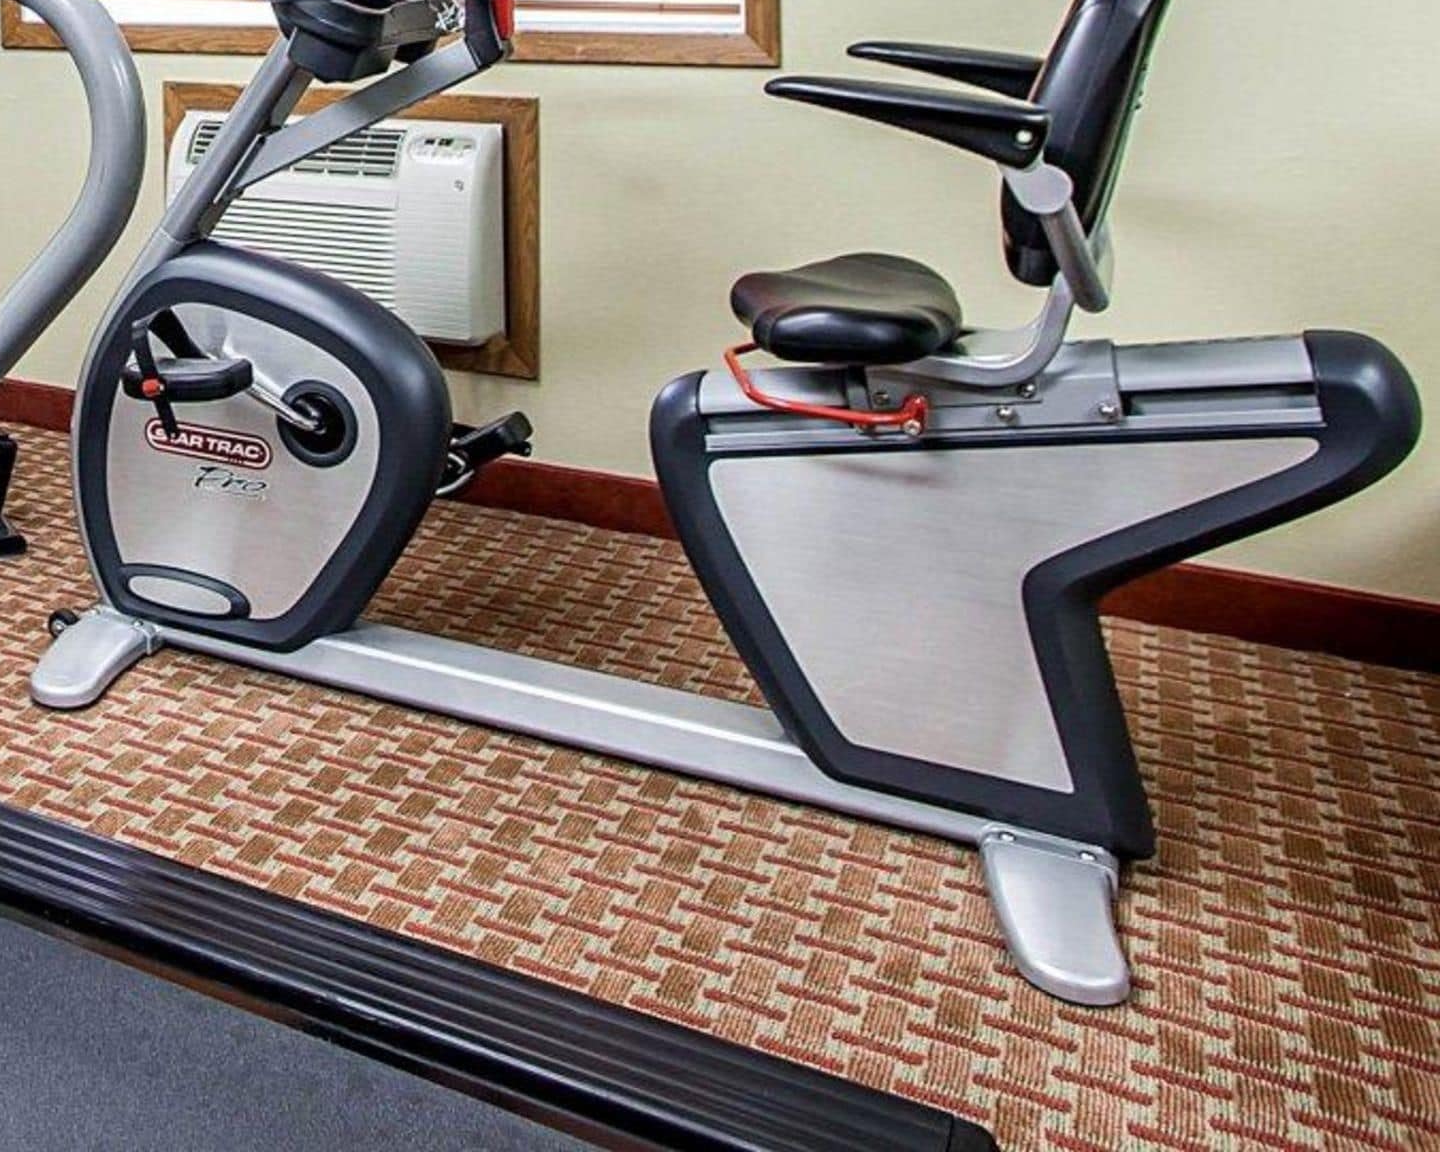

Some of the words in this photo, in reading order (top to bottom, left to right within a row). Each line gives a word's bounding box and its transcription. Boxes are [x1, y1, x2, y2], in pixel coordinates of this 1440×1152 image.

[154, 428, 204, 449] SAR
[206, 438, 260, 459] TRAC
[195, 466, 266, 490] Pro
